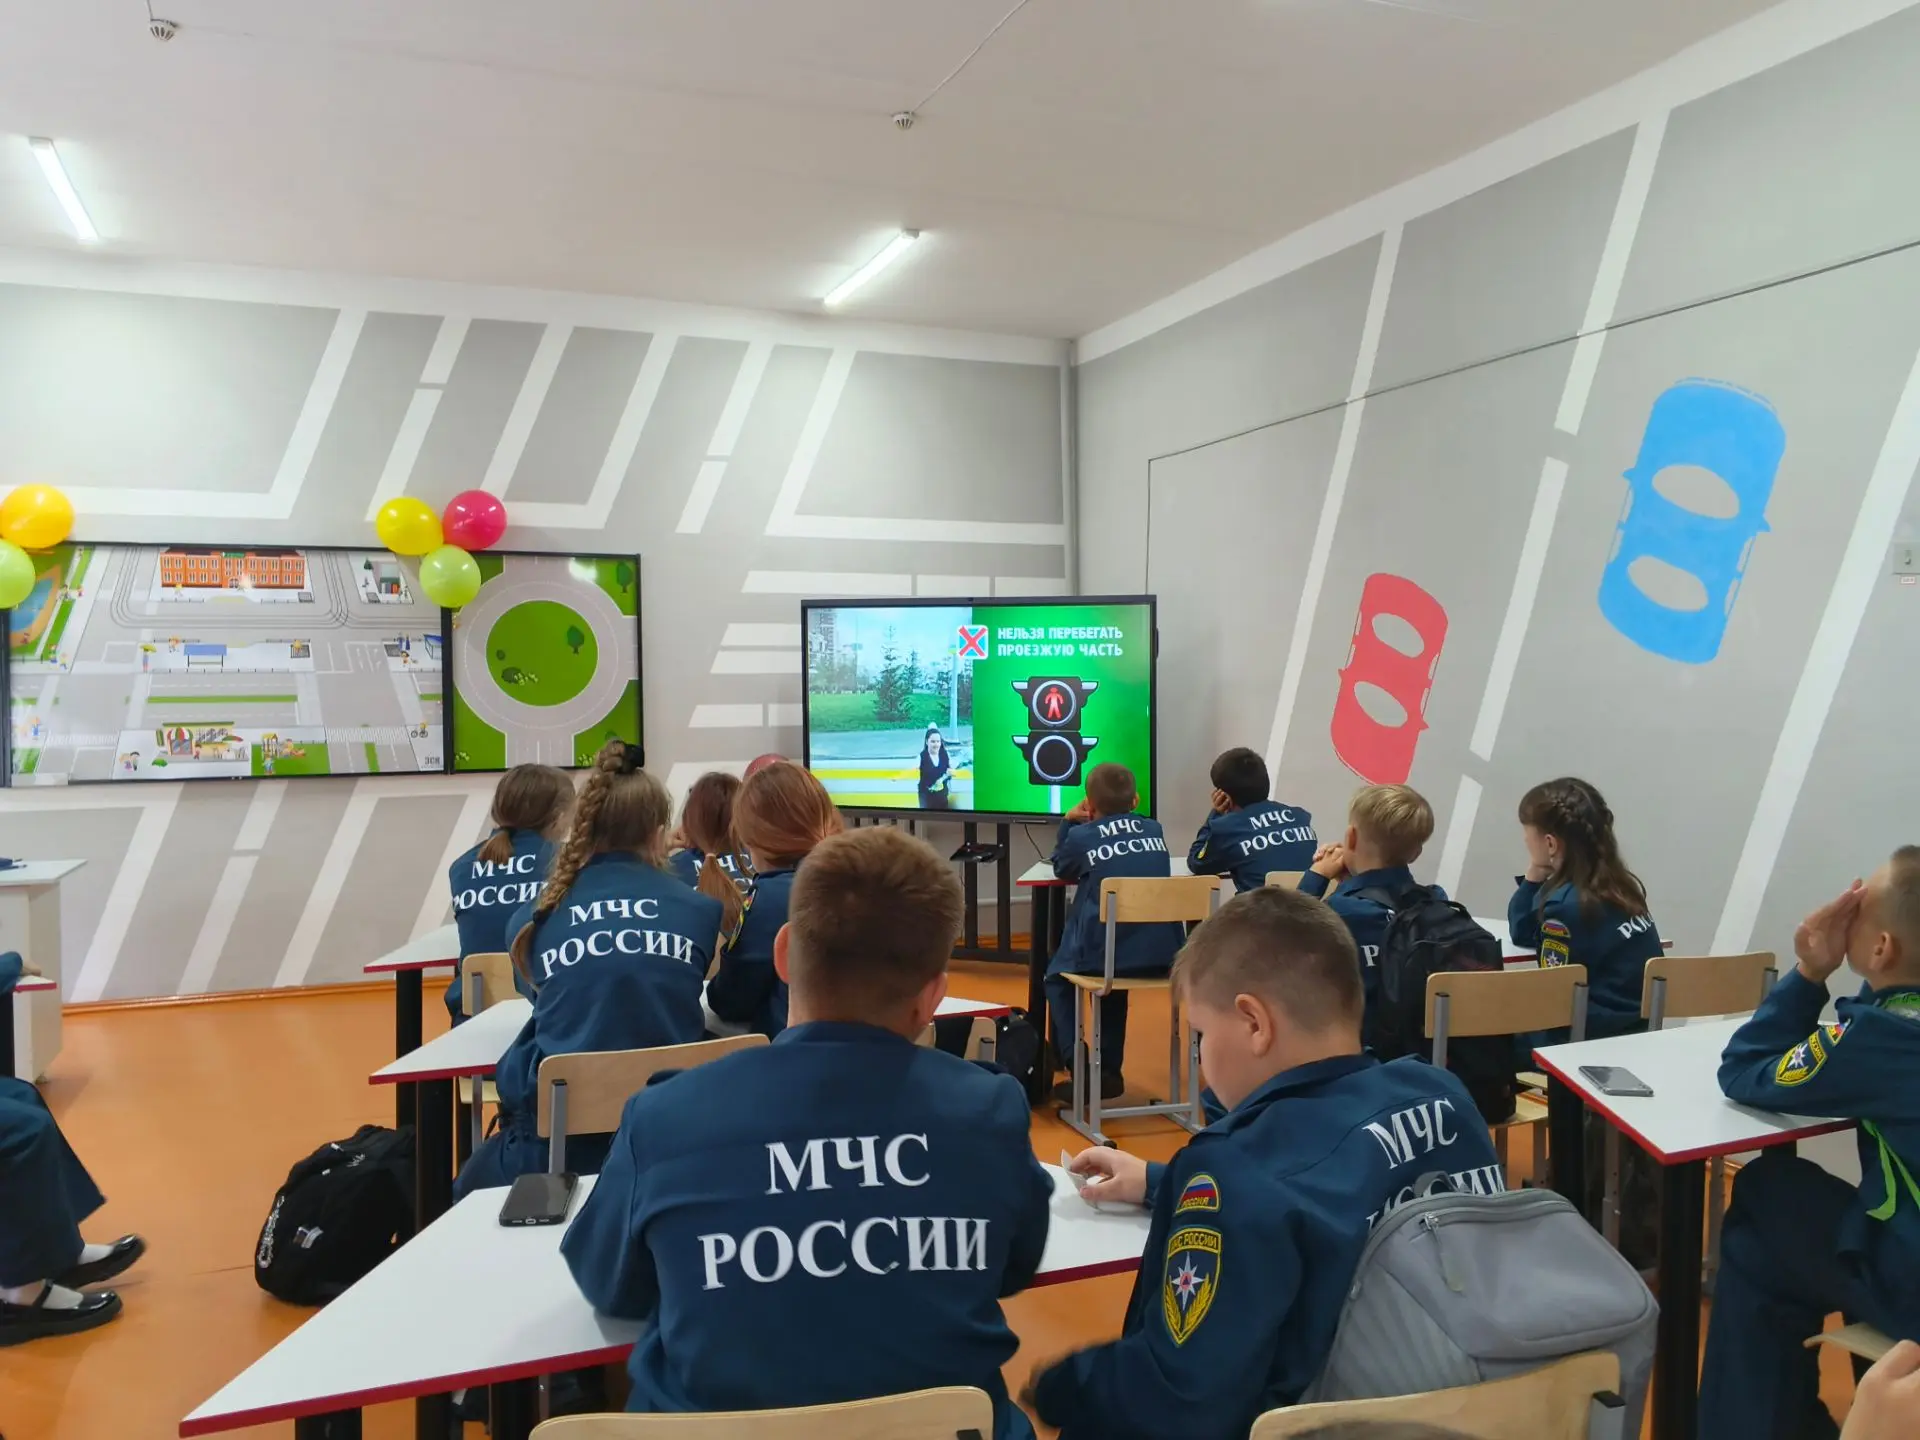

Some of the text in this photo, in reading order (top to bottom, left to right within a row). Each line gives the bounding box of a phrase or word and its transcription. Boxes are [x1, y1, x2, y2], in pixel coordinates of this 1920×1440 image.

[997, 626, 1123, 640] НЕЛЬЗЯ ПЕРЕБЕГАТЬ
[997, 643, 1123, 657] ПРОЕЗЖУЮ ЧАСТЬ
[1097, 818, 1144, 838] МЧС
[1249, 809, 1296, 830] МЧС
[471, 853, 536, 879] МЧС
[1086, 837, 1167, 867] РОССИИ
[453, 881, 549, 910] ОССИ
[569, 898, 660, 927] МЧС
[541, 928, 694, 979] РОССИИ
[1362, 1097, 1458, 1170] МЧС
[764, 1132, 931, 1195] МЧС
[697, 1216, 991, 1290] РОССИИ
